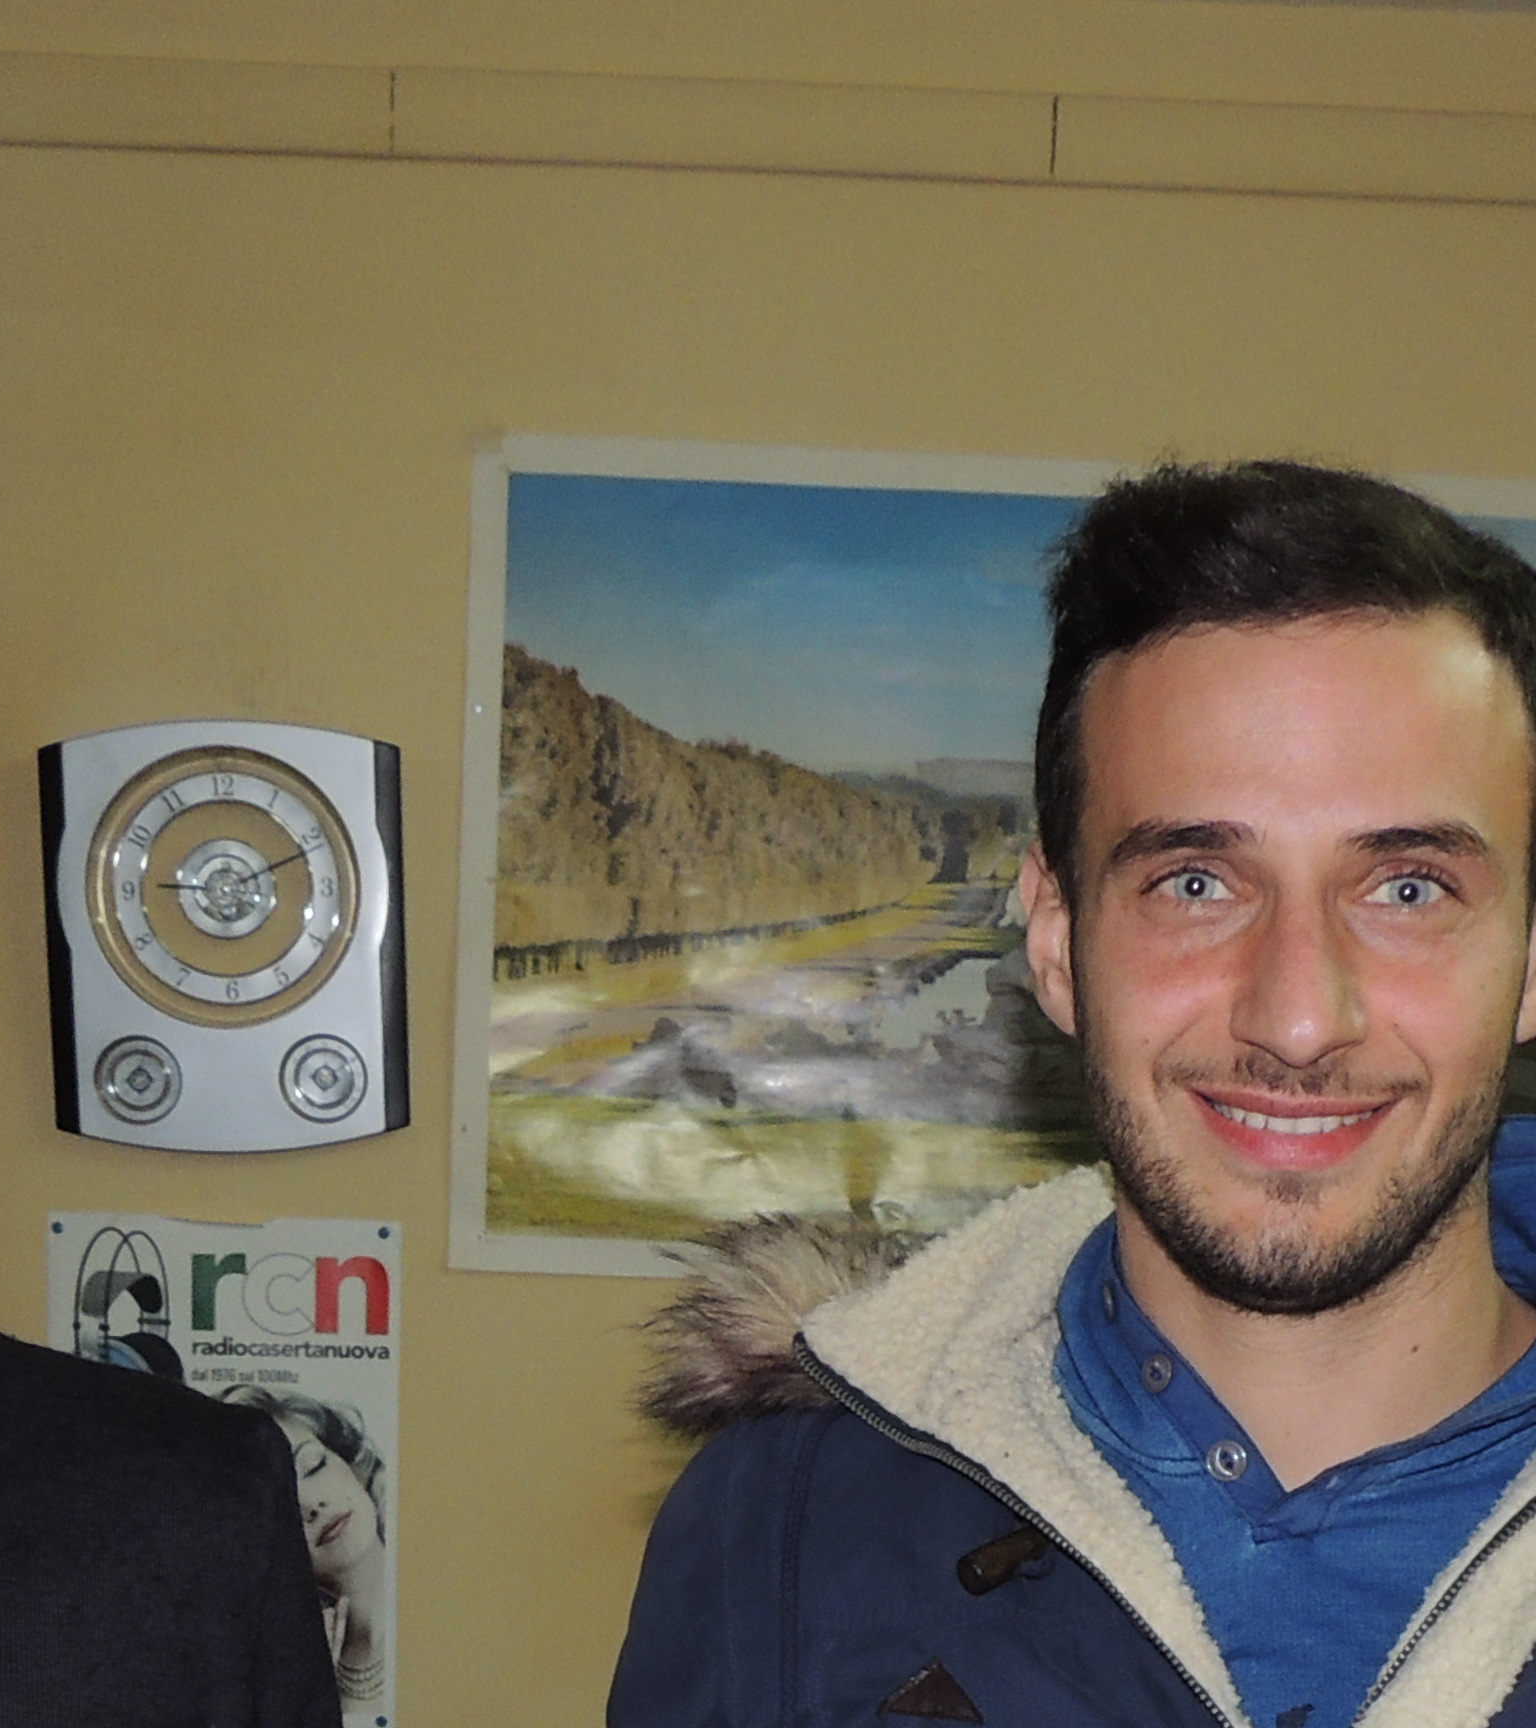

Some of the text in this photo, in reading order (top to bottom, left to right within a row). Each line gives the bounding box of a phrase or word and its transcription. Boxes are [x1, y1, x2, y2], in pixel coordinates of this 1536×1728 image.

[212, 776, 234, 796] 12
[163, 791, 184, 813] 11
[266, 790, 280, 808] 1
[128, 824, 151, 848] 10
[122, 881, 135, 902] 9
[320, 877, 333, 898] 3
[177, 967, 192, 987] 7
[273, 967, 290, 987] 5
[226, 982, 240, 1000] 6
[191, 1252, 390, 1336] rcn
[192, 1337, 391, 1360] radiocasertanuova
[211, 1368, 237, 1382] 1976
